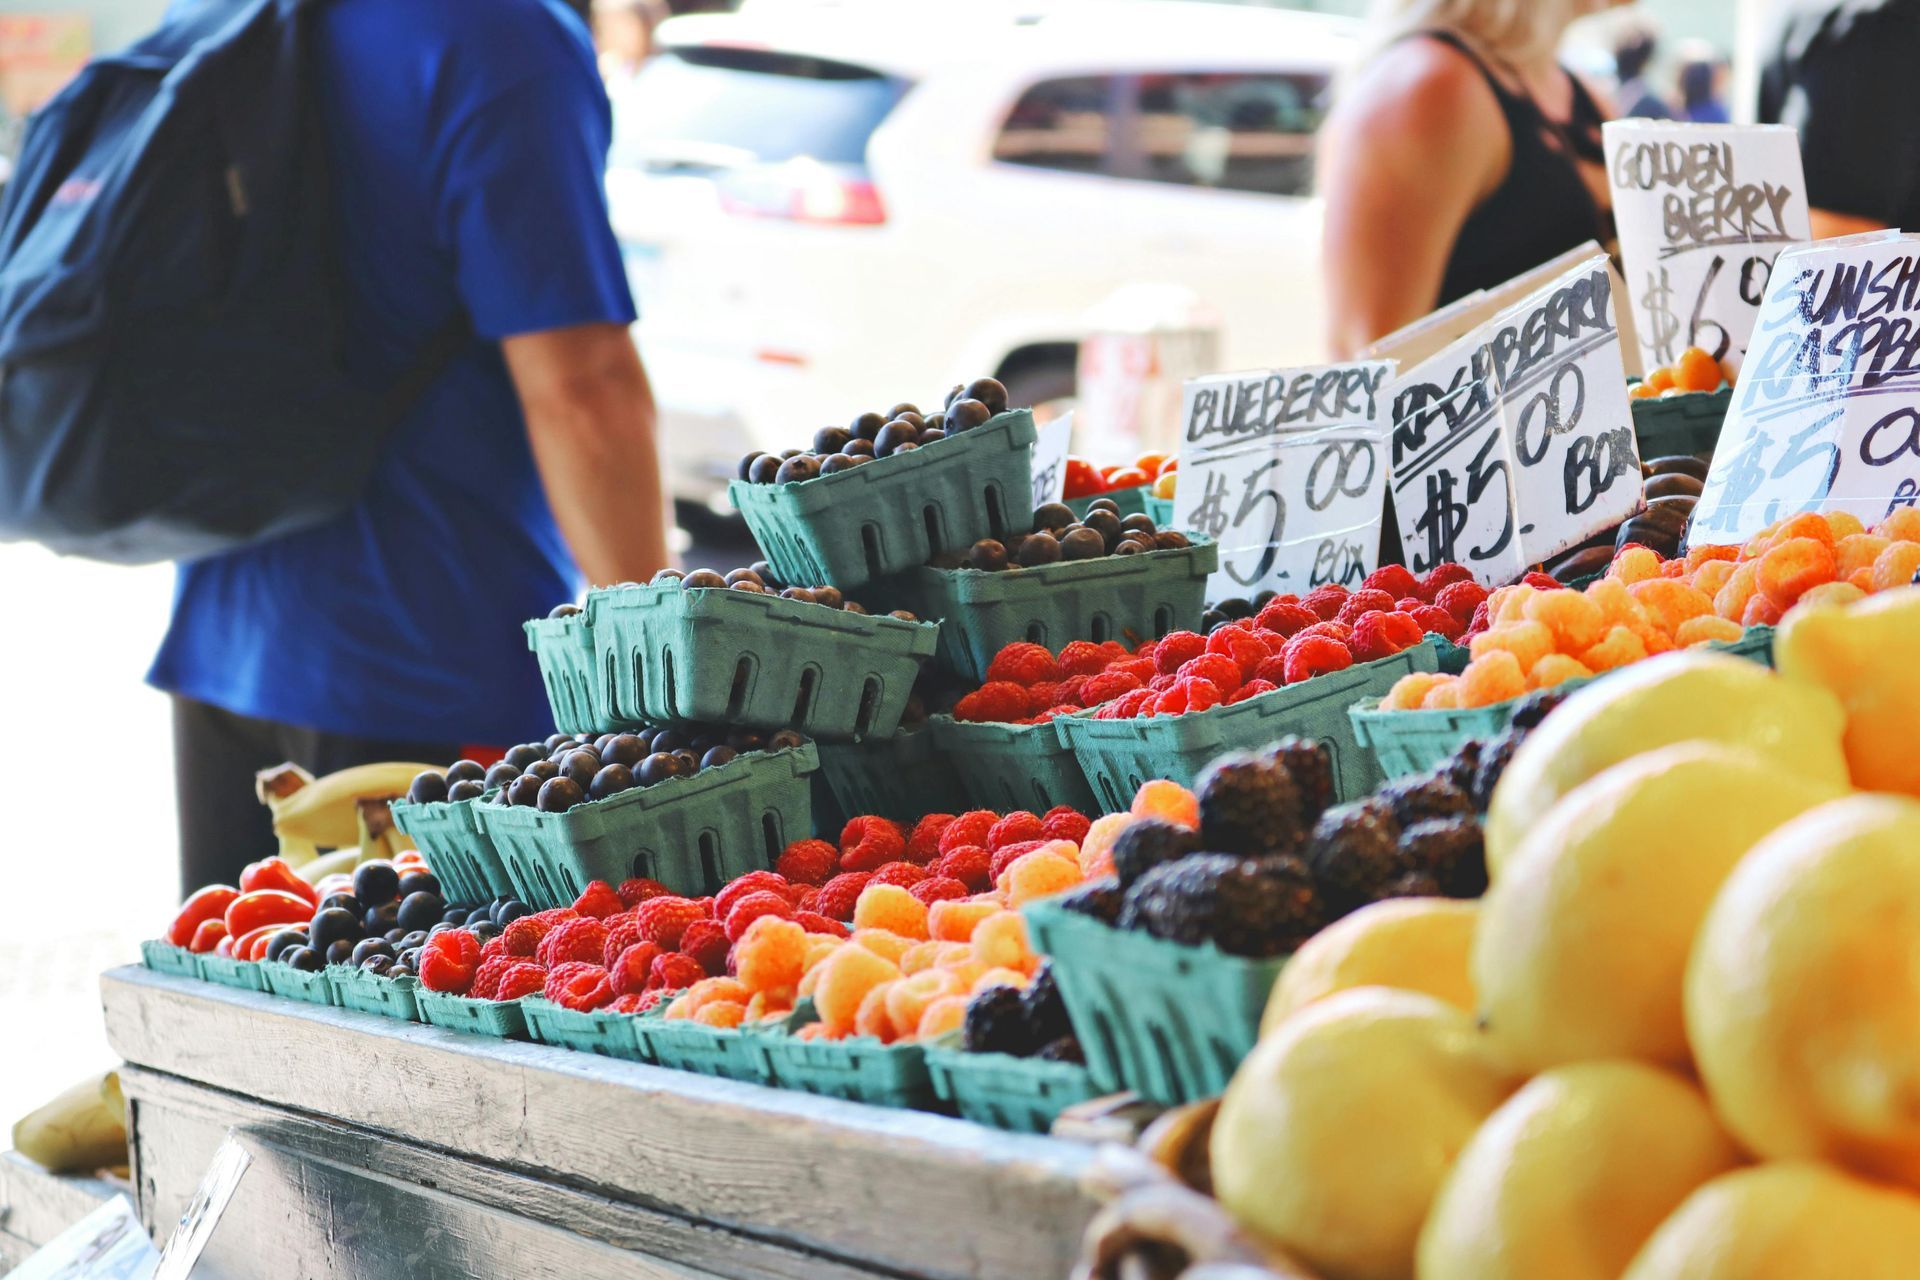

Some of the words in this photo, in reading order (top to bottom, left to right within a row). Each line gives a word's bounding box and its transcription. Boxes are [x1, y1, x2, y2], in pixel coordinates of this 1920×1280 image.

[1614, 141, 1734, 194] GOLDEN
[1663, 181, 1792, 244] BERRY
[1762, 255, 1920, 331] SUNSH
[1187, 365, 1387, 442] BLUEBERRY
